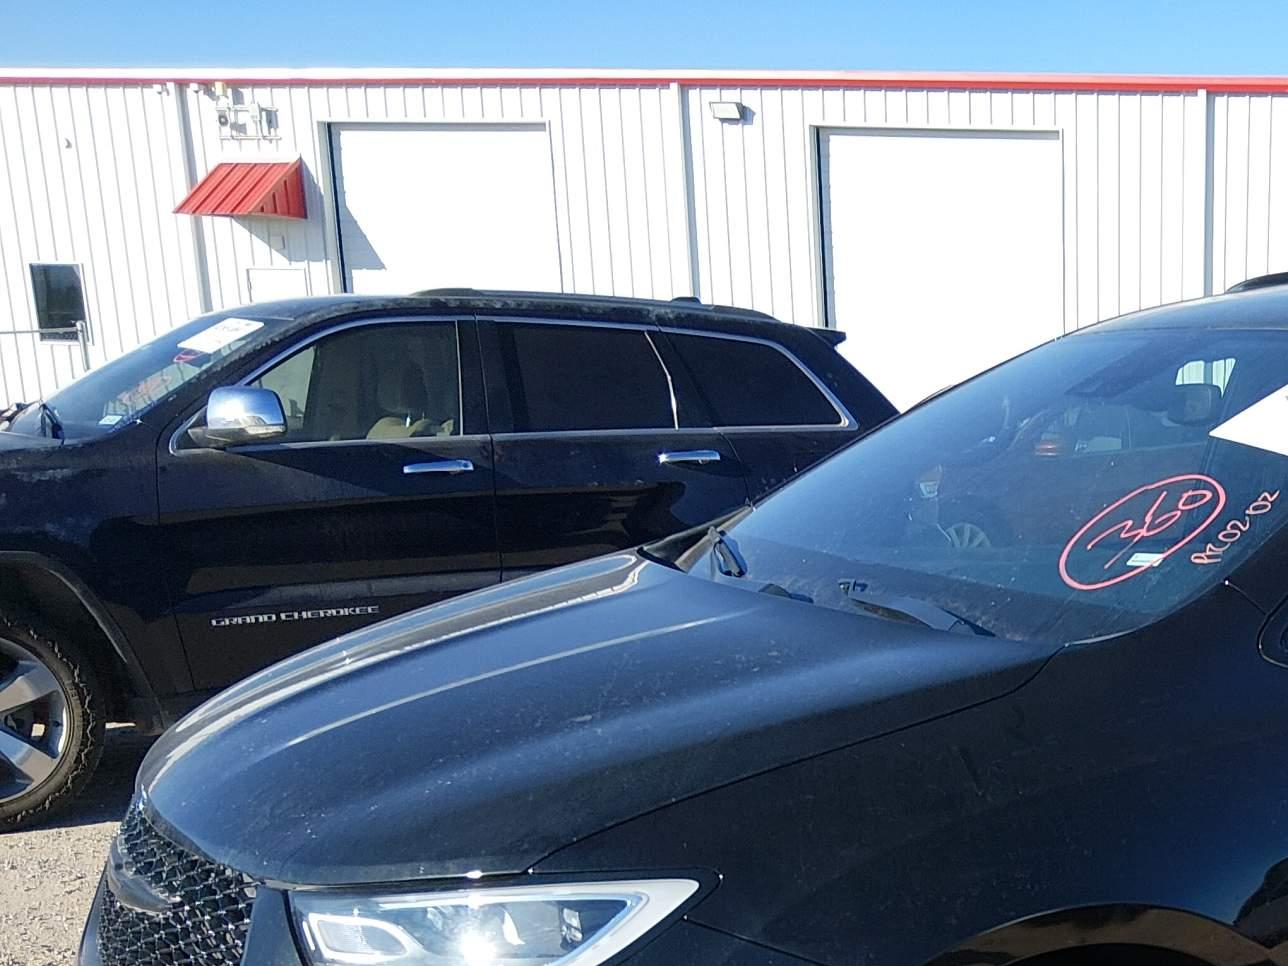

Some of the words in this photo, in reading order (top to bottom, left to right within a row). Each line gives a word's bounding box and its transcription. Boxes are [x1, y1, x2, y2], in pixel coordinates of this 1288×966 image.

[1086, 490, 1213, 570] 360
[210, 613, 276, 627] GRAND
[279, 605, 380, 621] CHEROKEE
